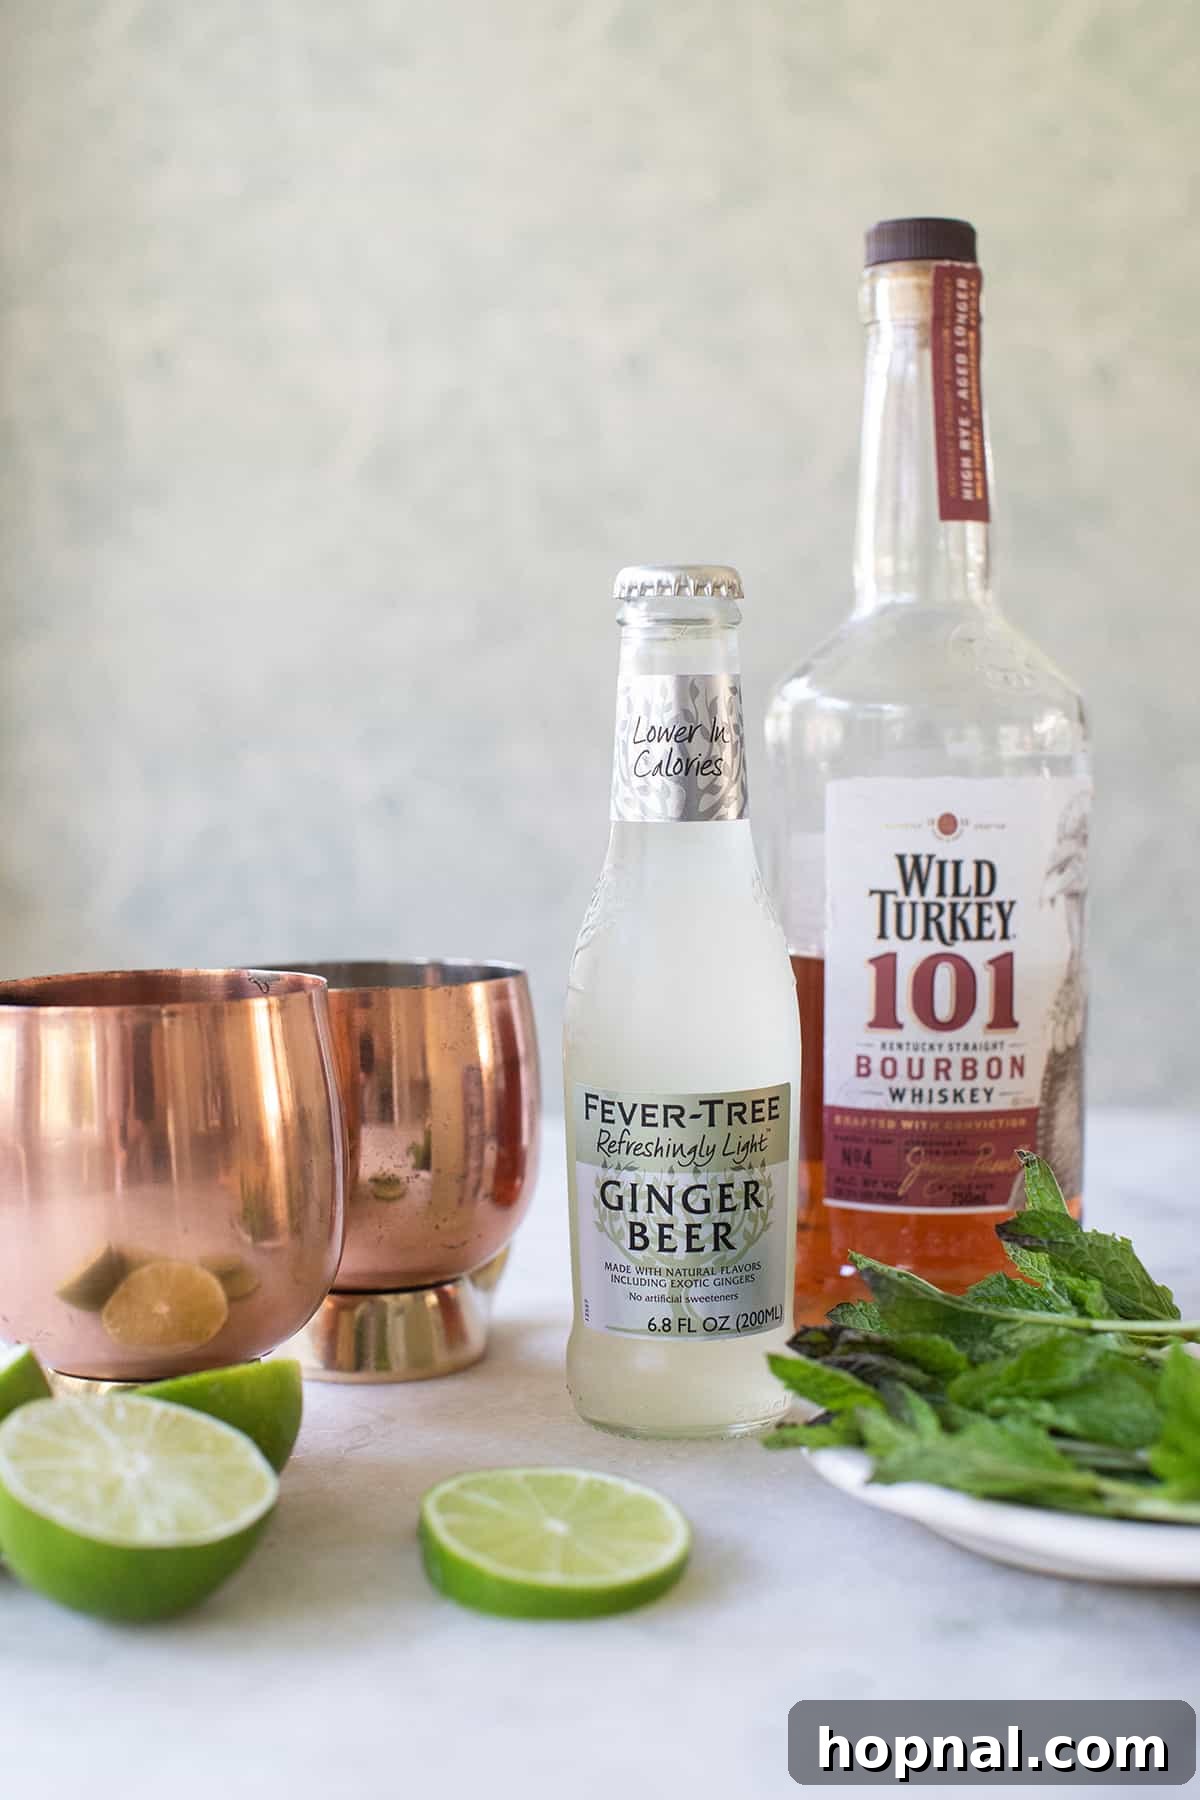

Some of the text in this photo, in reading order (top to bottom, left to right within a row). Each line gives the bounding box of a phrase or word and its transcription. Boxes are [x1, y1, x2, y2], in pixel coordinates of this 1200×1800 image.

[954, 277, 974, 501] HIGH RYE AGED LONGER
[632, 715, 730, 744] Lower In
[633, 747, 723, 777] Calories
[895, 853, 998, 898] WILD
[868, 889, 1016, 946] TURKEY
[865, 951, 1020, 1033] 101
[880, 1041, 1005, 1053] KENTUCKY STRAIGHT
[855, 1055, 1025, 1081] BOURBON
[584, 1092, 780, 1128] FEVER-TREE
[888, 1087, 995, 1104] WHISKEY
[901, 1117, 937, 1130] WITH
[596, 1128, 716, 1167] Refreshingly
[600, 1180, 764, 1215] GINGER
[628, 1221, 737, 1252] BEER
[604, 1261, 762, 1277] MADE WITH NATURAL FLAVORS
[610, 1274, 756, 1289] INCLUDING EXOTIC GINGERS
[629, 1292, 740, 1304] No artificial sweeteners
[647, 1304, 783, 1333] 6.8 FL OZ (200ML)
